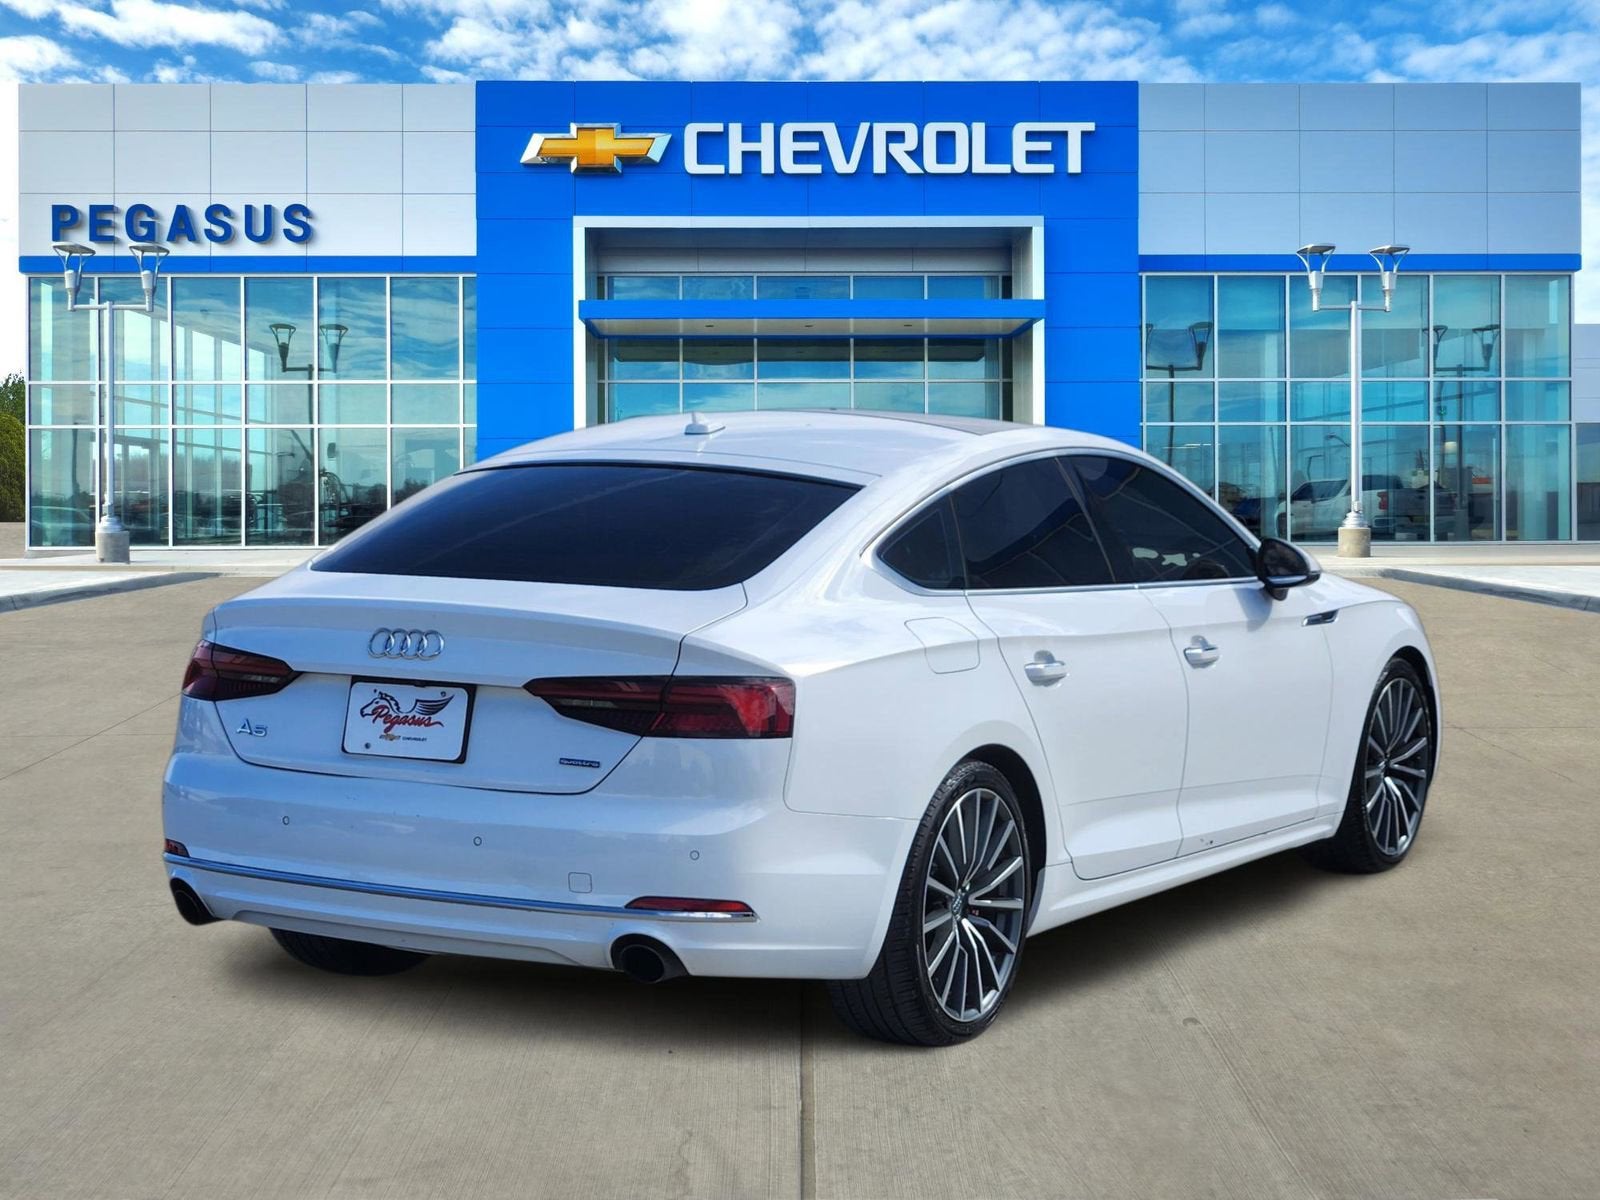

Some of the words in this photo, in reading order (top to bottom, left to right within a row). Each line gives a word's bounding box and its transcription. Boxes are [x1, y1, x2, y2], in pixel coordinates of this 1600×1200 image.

[683, 121, 1096, 175] CHEVROLET
[51, 203, 314, 243] PEGASUS
[236, 718, 268, 737] A5
[371, 704, 444, 734] Pegasus
